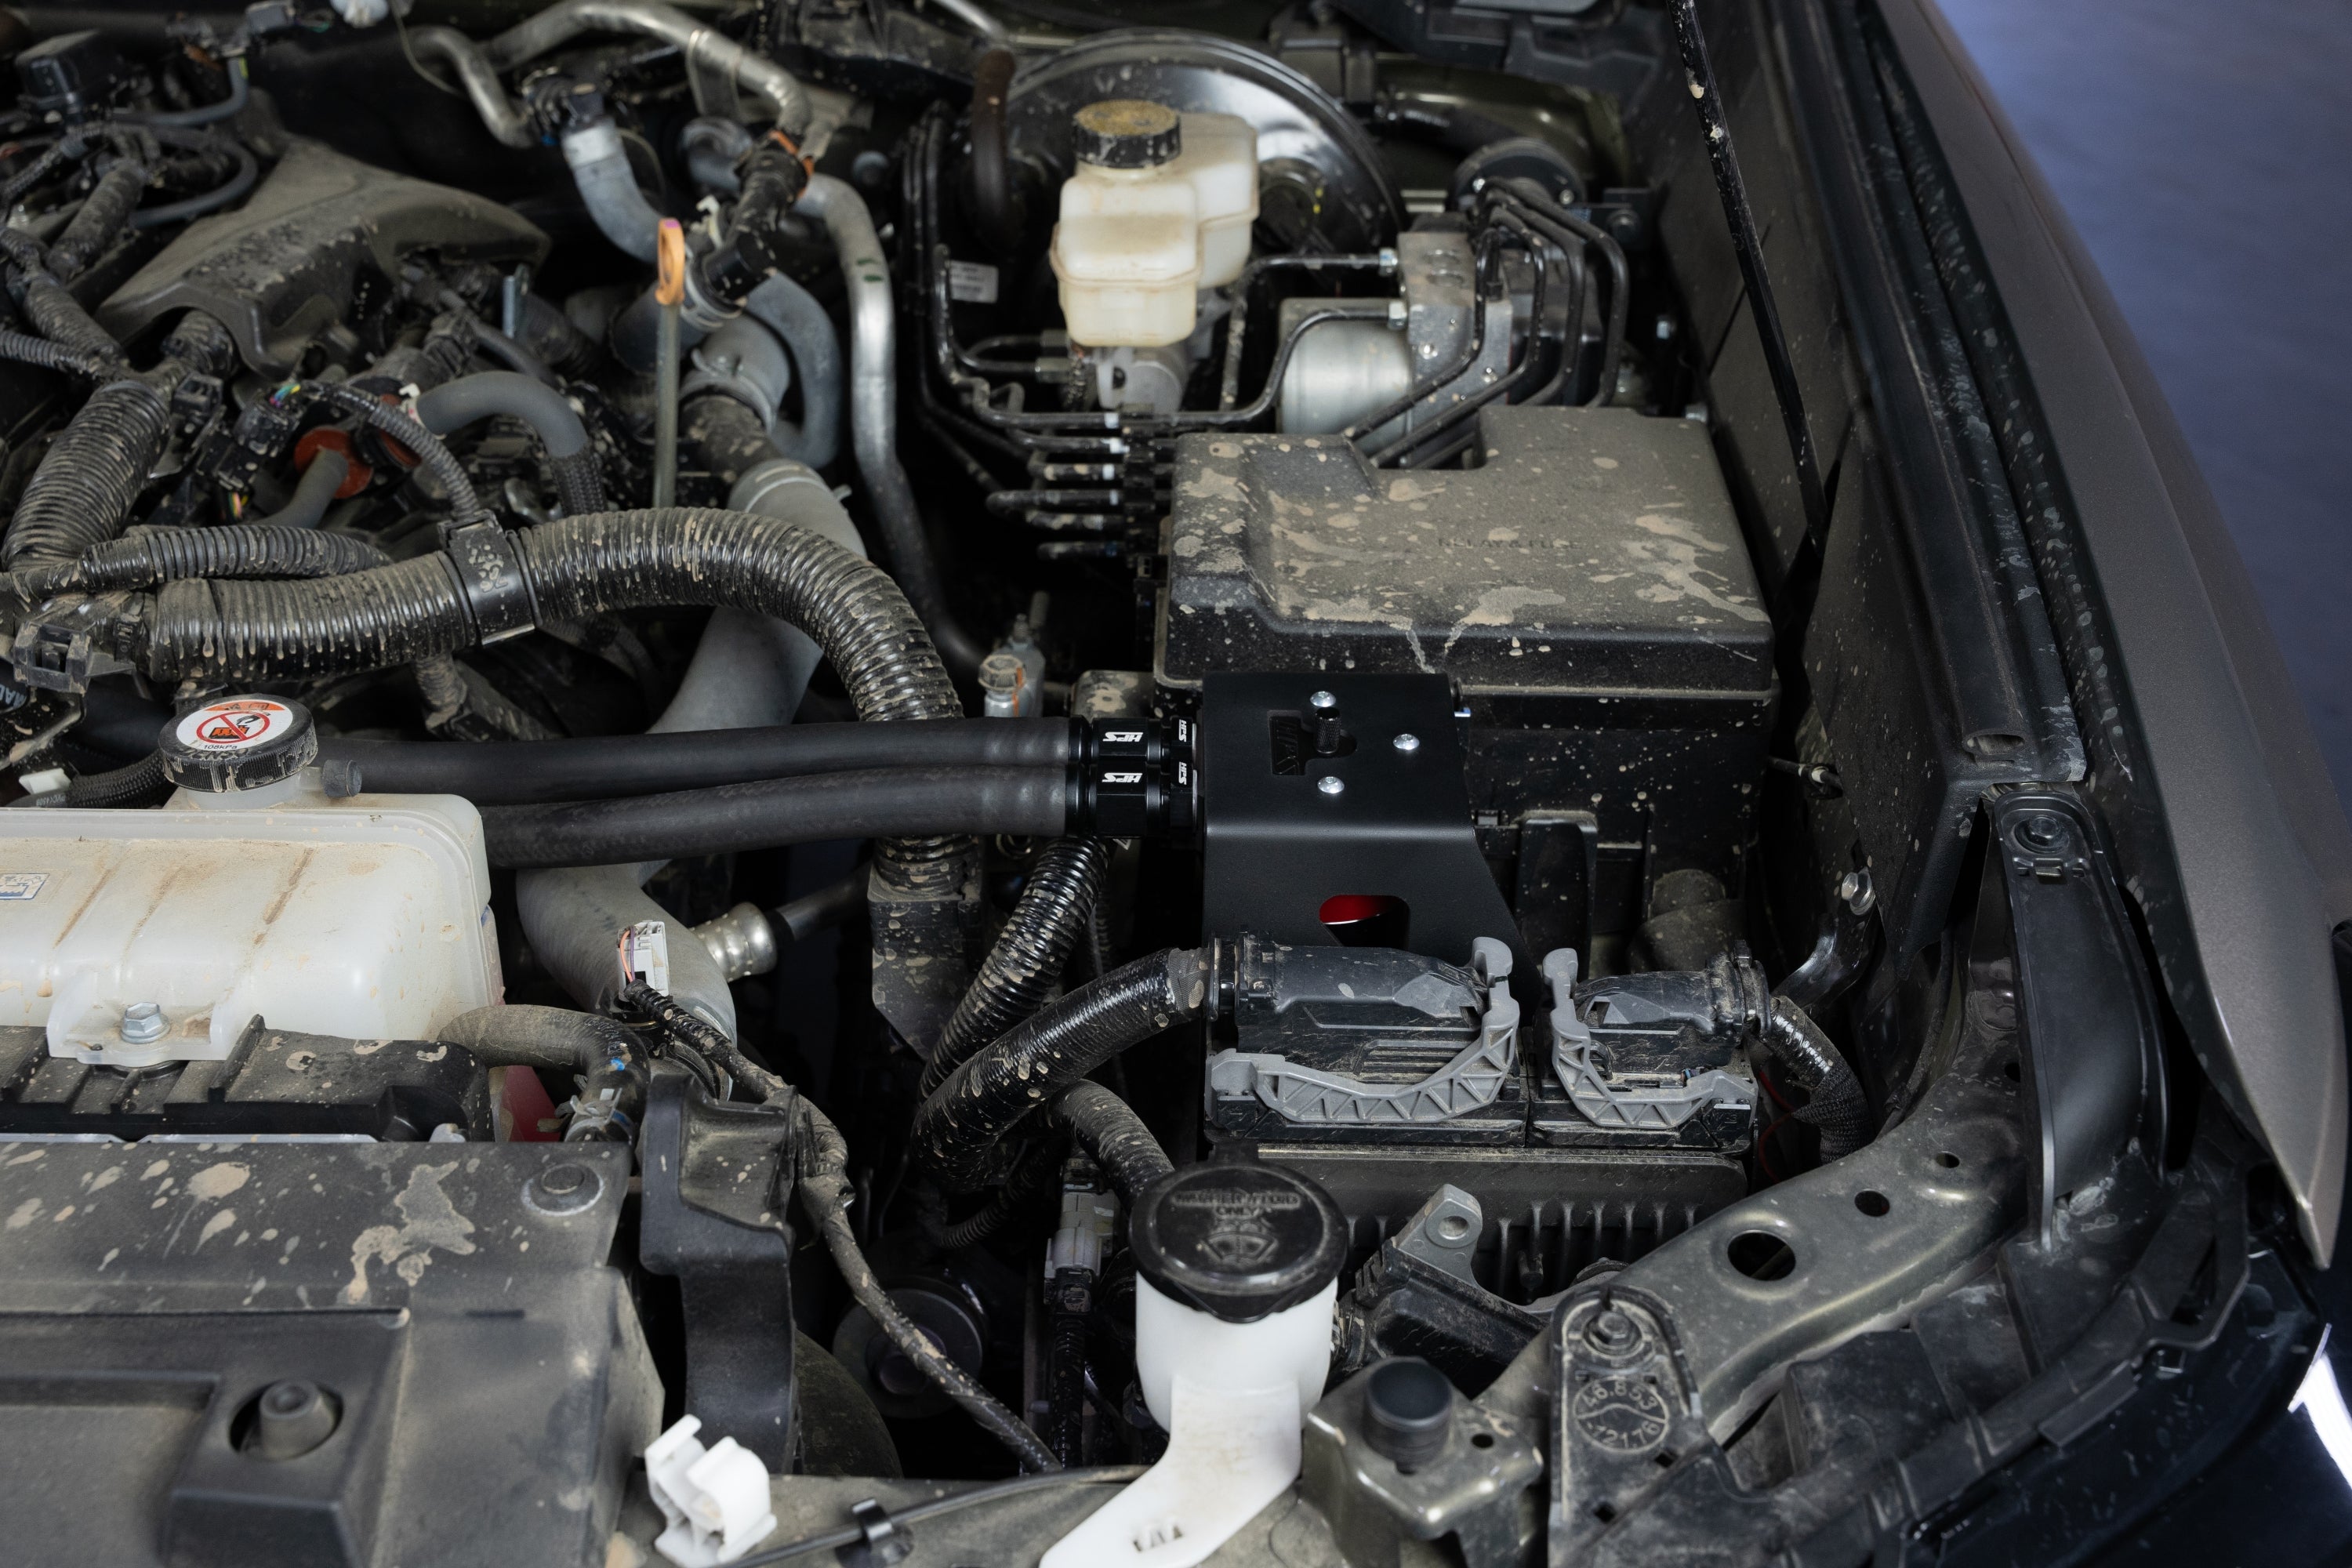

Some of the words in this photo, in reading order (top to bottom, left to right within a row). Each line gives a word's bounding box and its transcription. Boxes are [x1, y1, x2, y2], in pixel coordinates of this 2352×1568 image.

[1102, 731, 1144, 742] HPS
[1178, 719, 1187, 742] HPS
[1102, 772, 1143, 783] HPS
[1178, 761, 1187, 785] HPS
